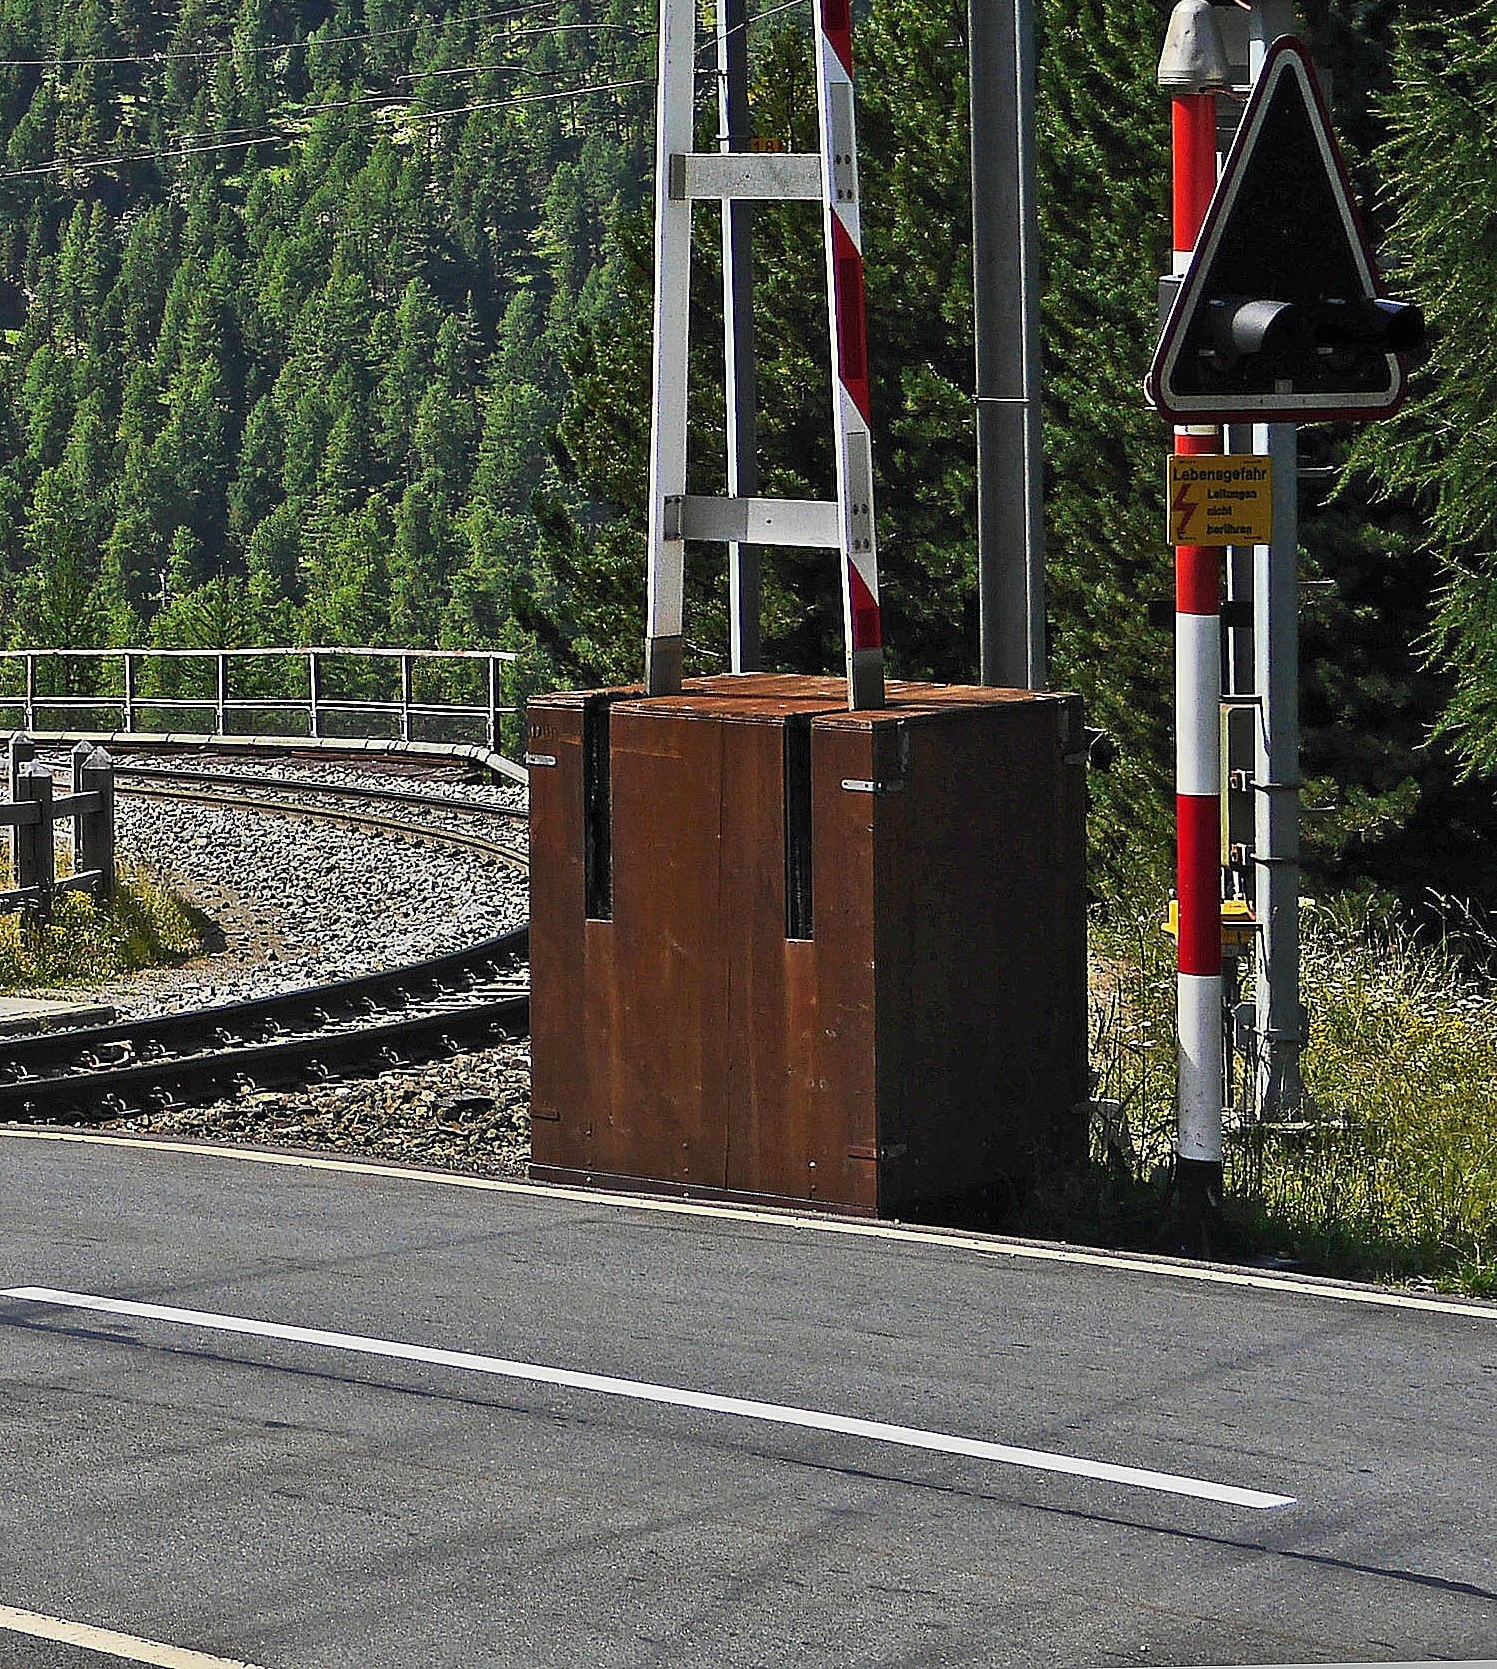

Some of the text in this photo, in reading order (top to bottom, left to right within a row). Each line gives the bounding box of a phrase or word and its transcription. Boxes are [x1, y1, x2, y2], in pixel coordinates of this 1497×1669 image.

[1173, 466, 1267, 482] Lebensgefahr
[1207, 489, 1257, 500] Leitungen
[1207, 505, 1233, 516] nicht
[1206, 523, 1252, 534] berühren
